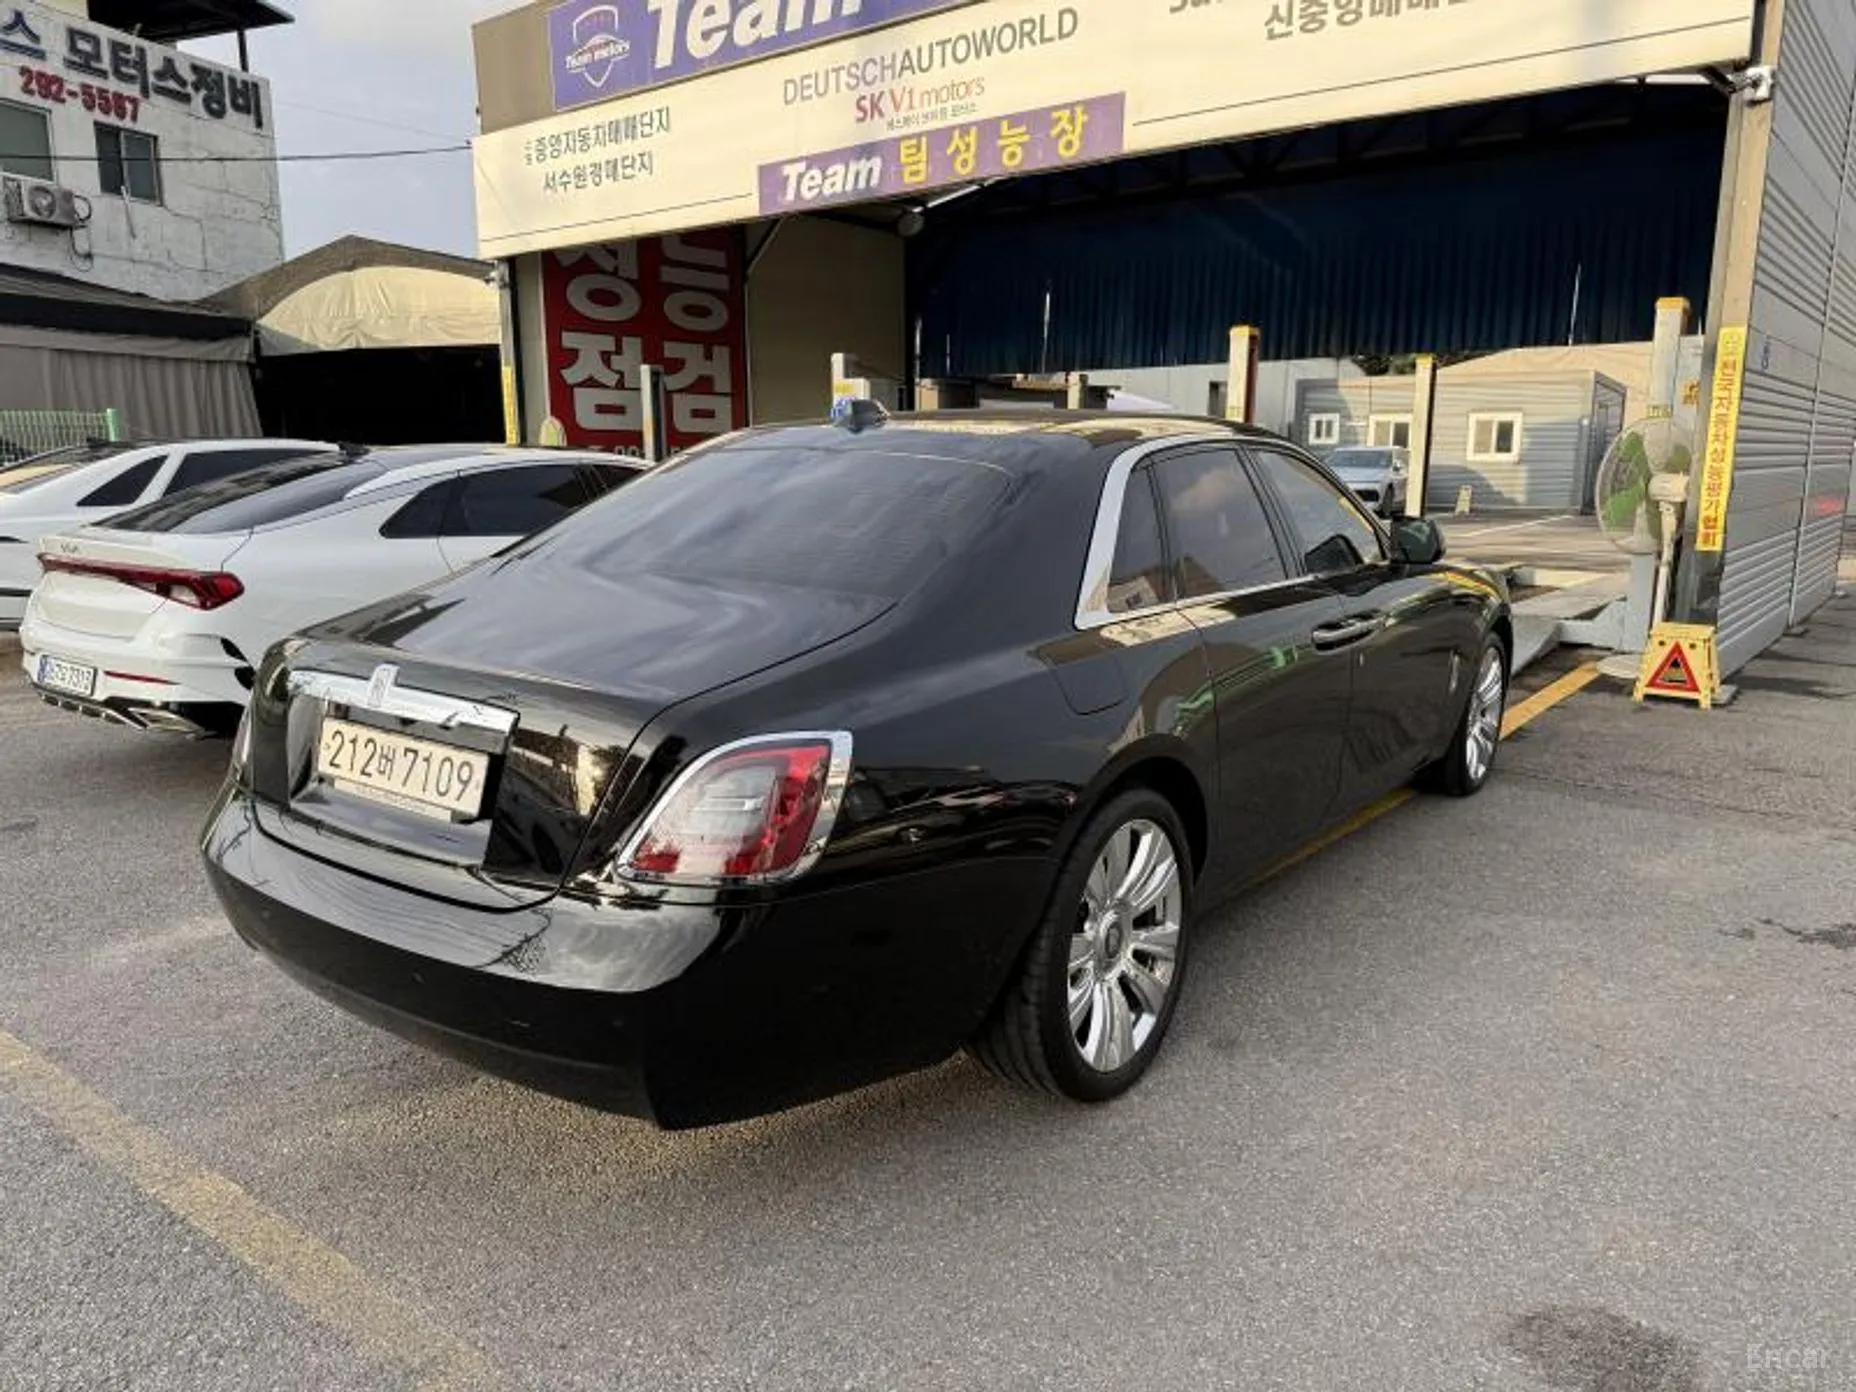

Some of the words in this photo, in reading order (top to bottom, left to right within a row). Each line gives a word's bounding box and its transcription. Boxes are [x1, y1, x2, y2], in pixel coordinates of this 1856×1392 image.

[1264, 0, 1468, 41] 신중앙
[63, 27, 263, 130] 모터스정비
[783, 7, 1079, 106] DEUTSCHAUTOWORLD
[855, 90, 886, 124] SK
[919, 76, 986, 108] motors
[781, 153, 883, 203] Team
